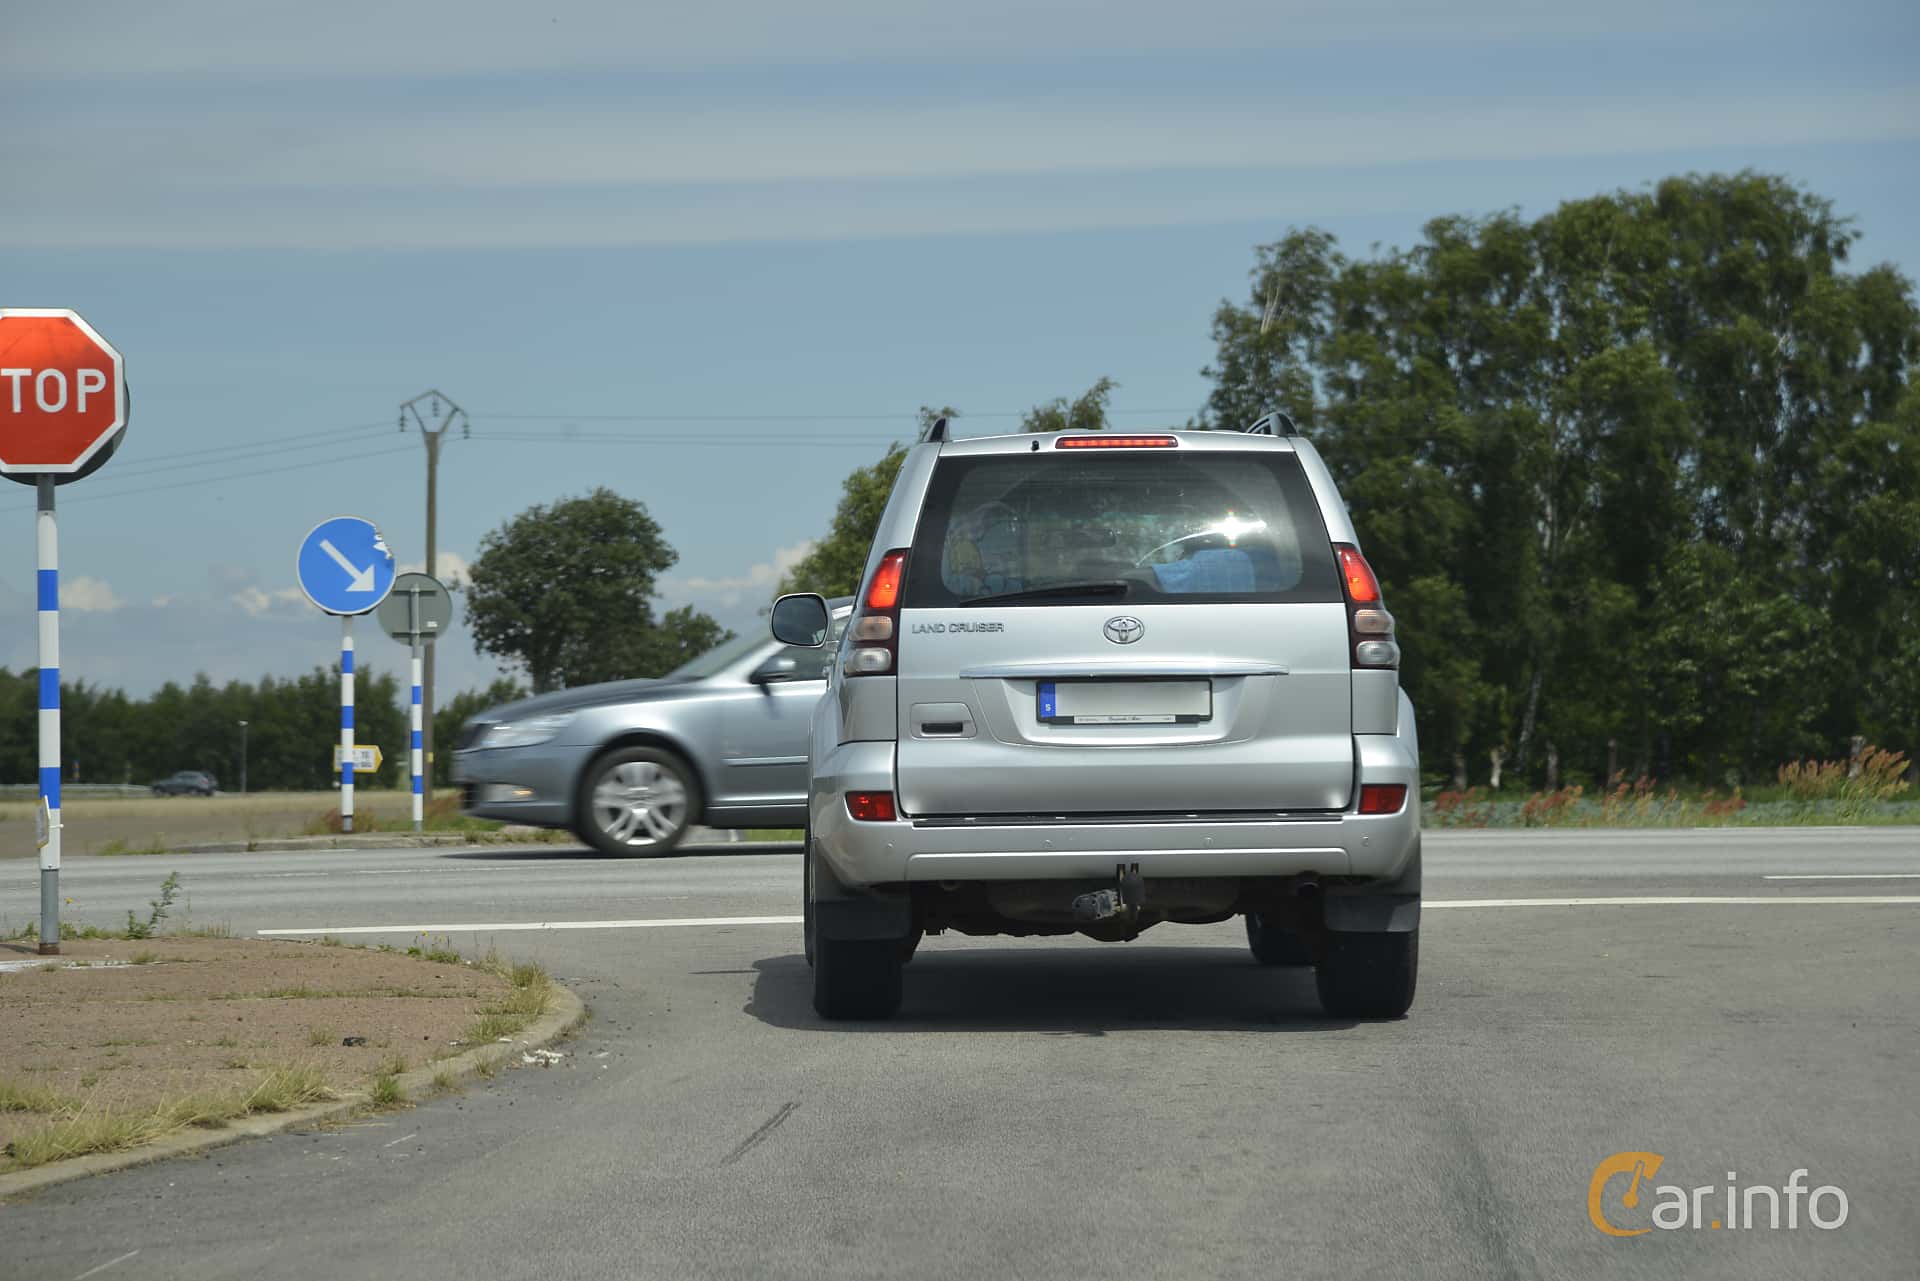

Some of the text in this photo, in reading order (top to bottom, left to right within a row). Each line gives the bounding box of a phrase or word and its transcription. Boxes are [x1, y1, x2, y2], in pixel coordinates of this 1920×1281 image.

[0, 368, 106, 413] TOP
[912, 622, 1004, 634] LAND CRUISER
[1045, 703, 1051, 712] S
